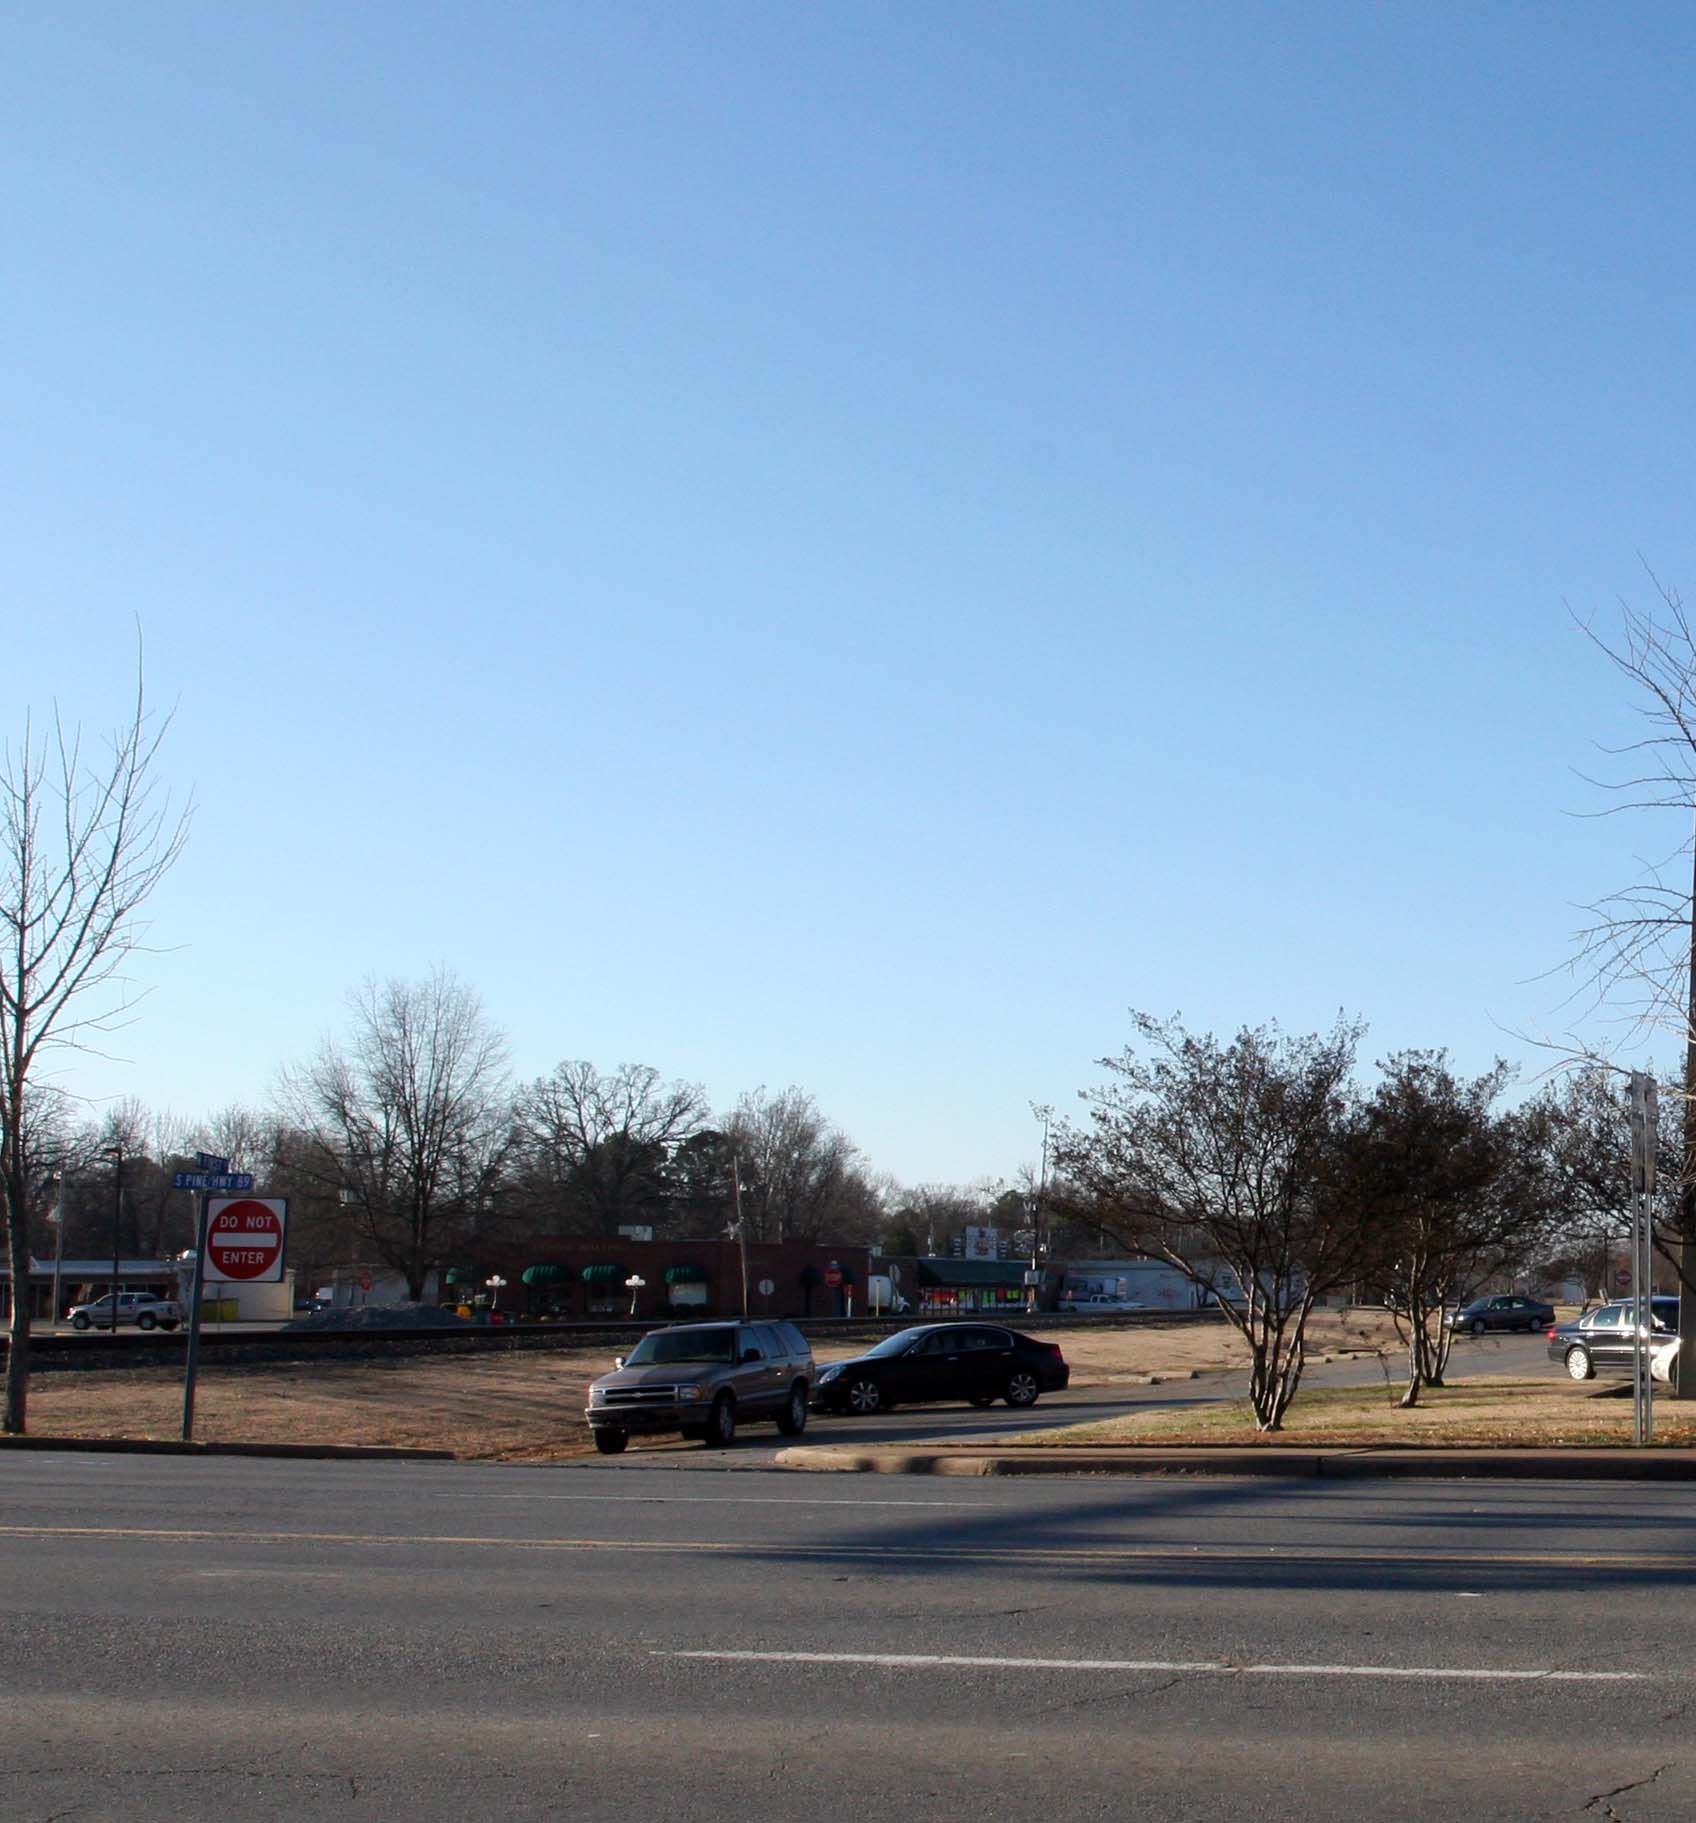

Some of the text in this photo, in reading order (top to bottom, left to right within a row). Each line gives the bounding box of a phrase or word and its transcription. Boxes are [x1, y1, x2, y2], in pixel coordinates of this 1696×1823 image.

[175, 1174, 184, 1187] S
[220, 1216, 273, 1228] DO NOT
[222, 1251, 265, 1264] ENTER
